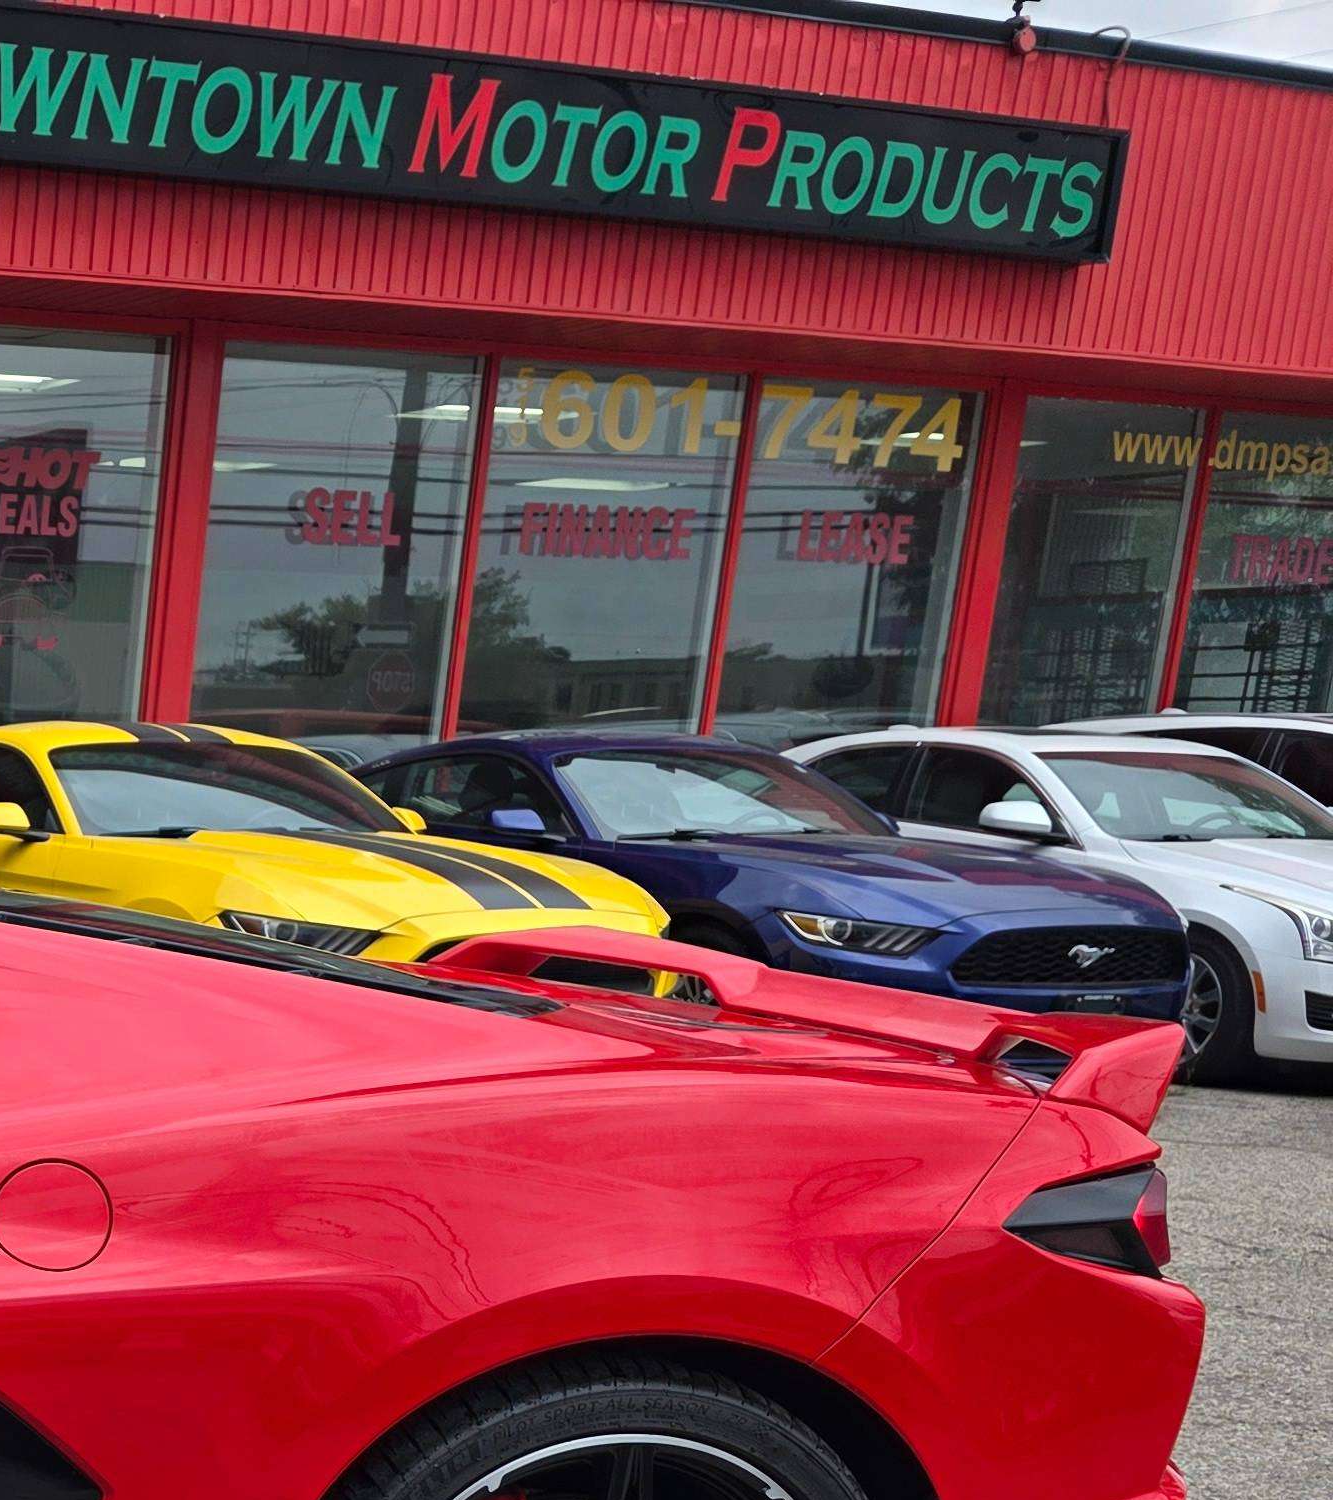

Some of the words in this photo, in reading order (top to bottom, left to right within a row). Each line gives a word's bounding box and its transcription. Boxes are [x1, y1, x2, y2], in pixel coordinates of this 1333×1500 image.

[408, 73, 701, 198] MOTOR
[711, 107, 1103, 237] PRODUCTS
[302, 486, 401, 547] SELL
[519, 501, 696, 561] FINANCE
[796, 508, 915, 566] LEASE
[642, 1400, 711, 1417] SEASON
